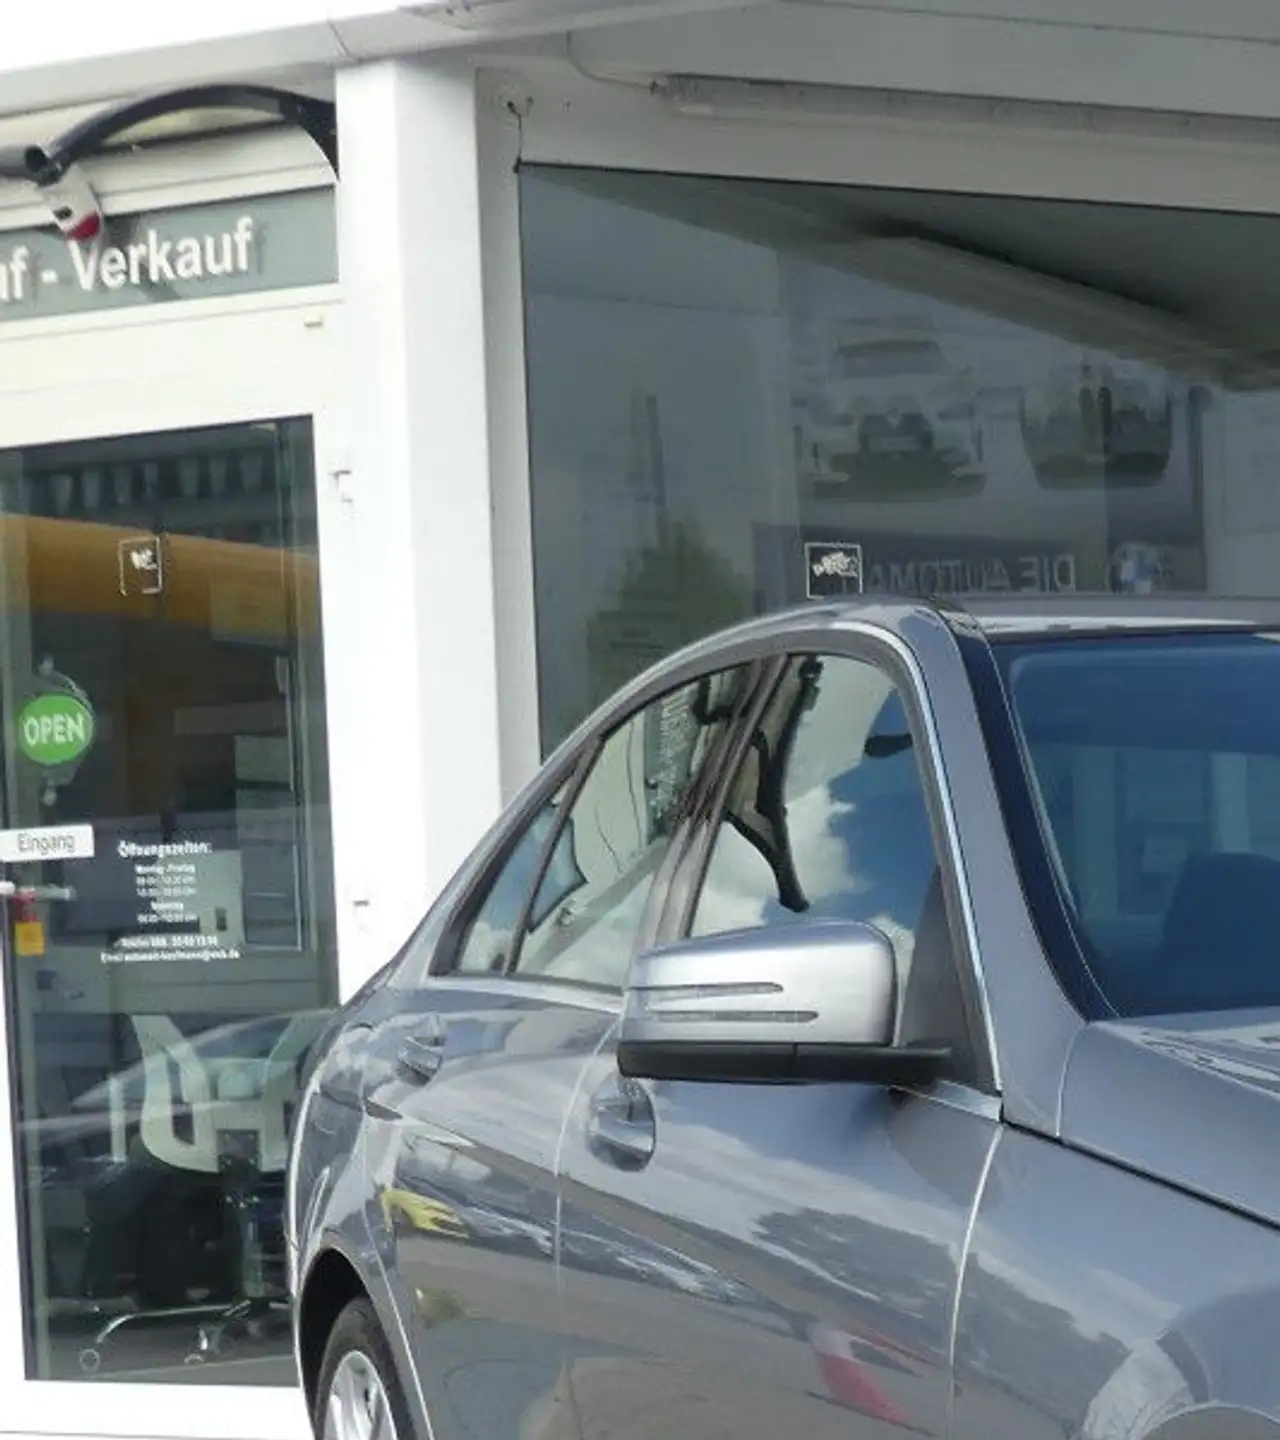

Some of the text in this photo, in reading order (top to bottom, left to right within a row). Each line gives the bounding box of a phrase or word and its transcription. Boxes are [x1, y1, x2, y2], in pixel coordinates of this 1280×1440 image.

[67, 216, 254, 291] Verkauf
[23, 712, 85, 748] OPEN
[17, 833, 76, 855] Eingang
